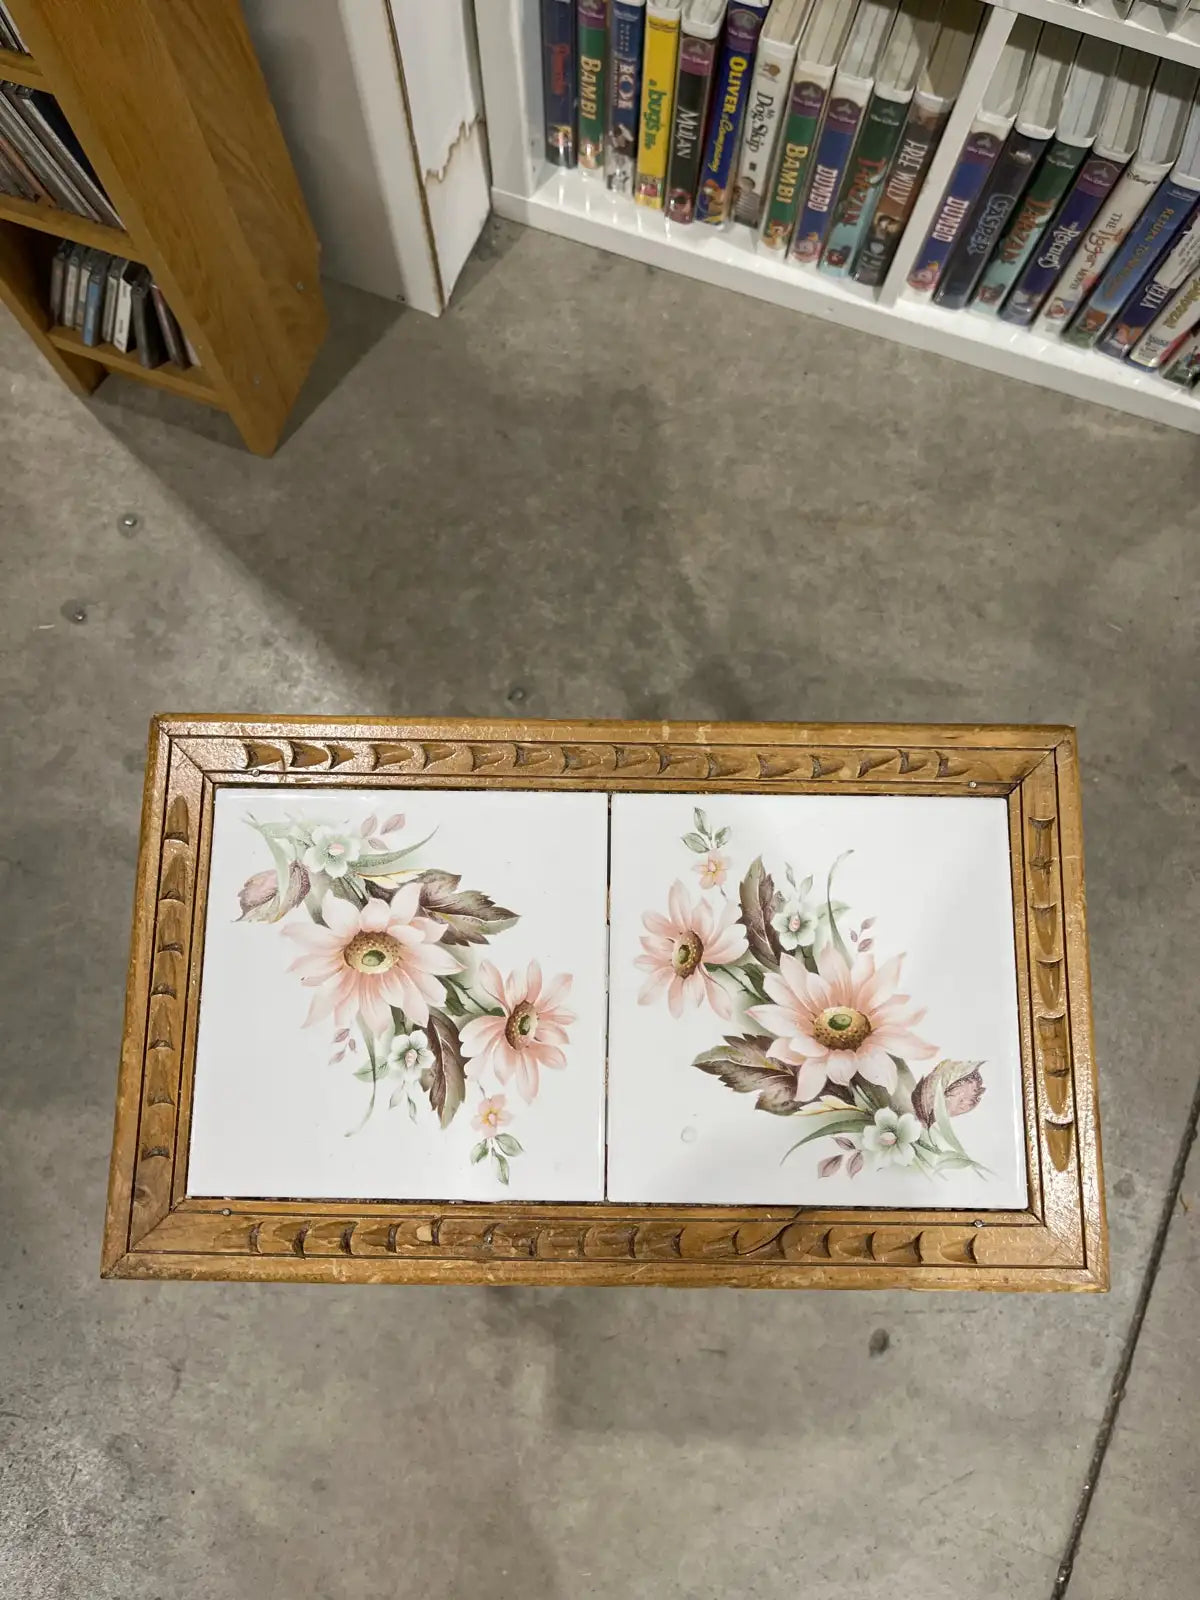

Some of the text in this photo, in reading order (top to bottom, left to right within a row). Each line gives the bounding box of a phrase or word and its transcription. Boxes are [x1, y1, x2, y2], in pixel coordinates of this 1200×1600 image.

[581, 56, 602, 120] BAMBI
[722, 56, 748, 114] OLIVER
[676, 105, 699, 159] MULAN
[745, 123, 768, 153] Skip
[776, 142, 809, 204] BAMBI
[807, 164, 839, 213] DUMBO
[886, 138, 929, 206] FREE WILLY
[931, 195, 970, 243] DUMBO
[967, 193, 1016, 257] CASPER
